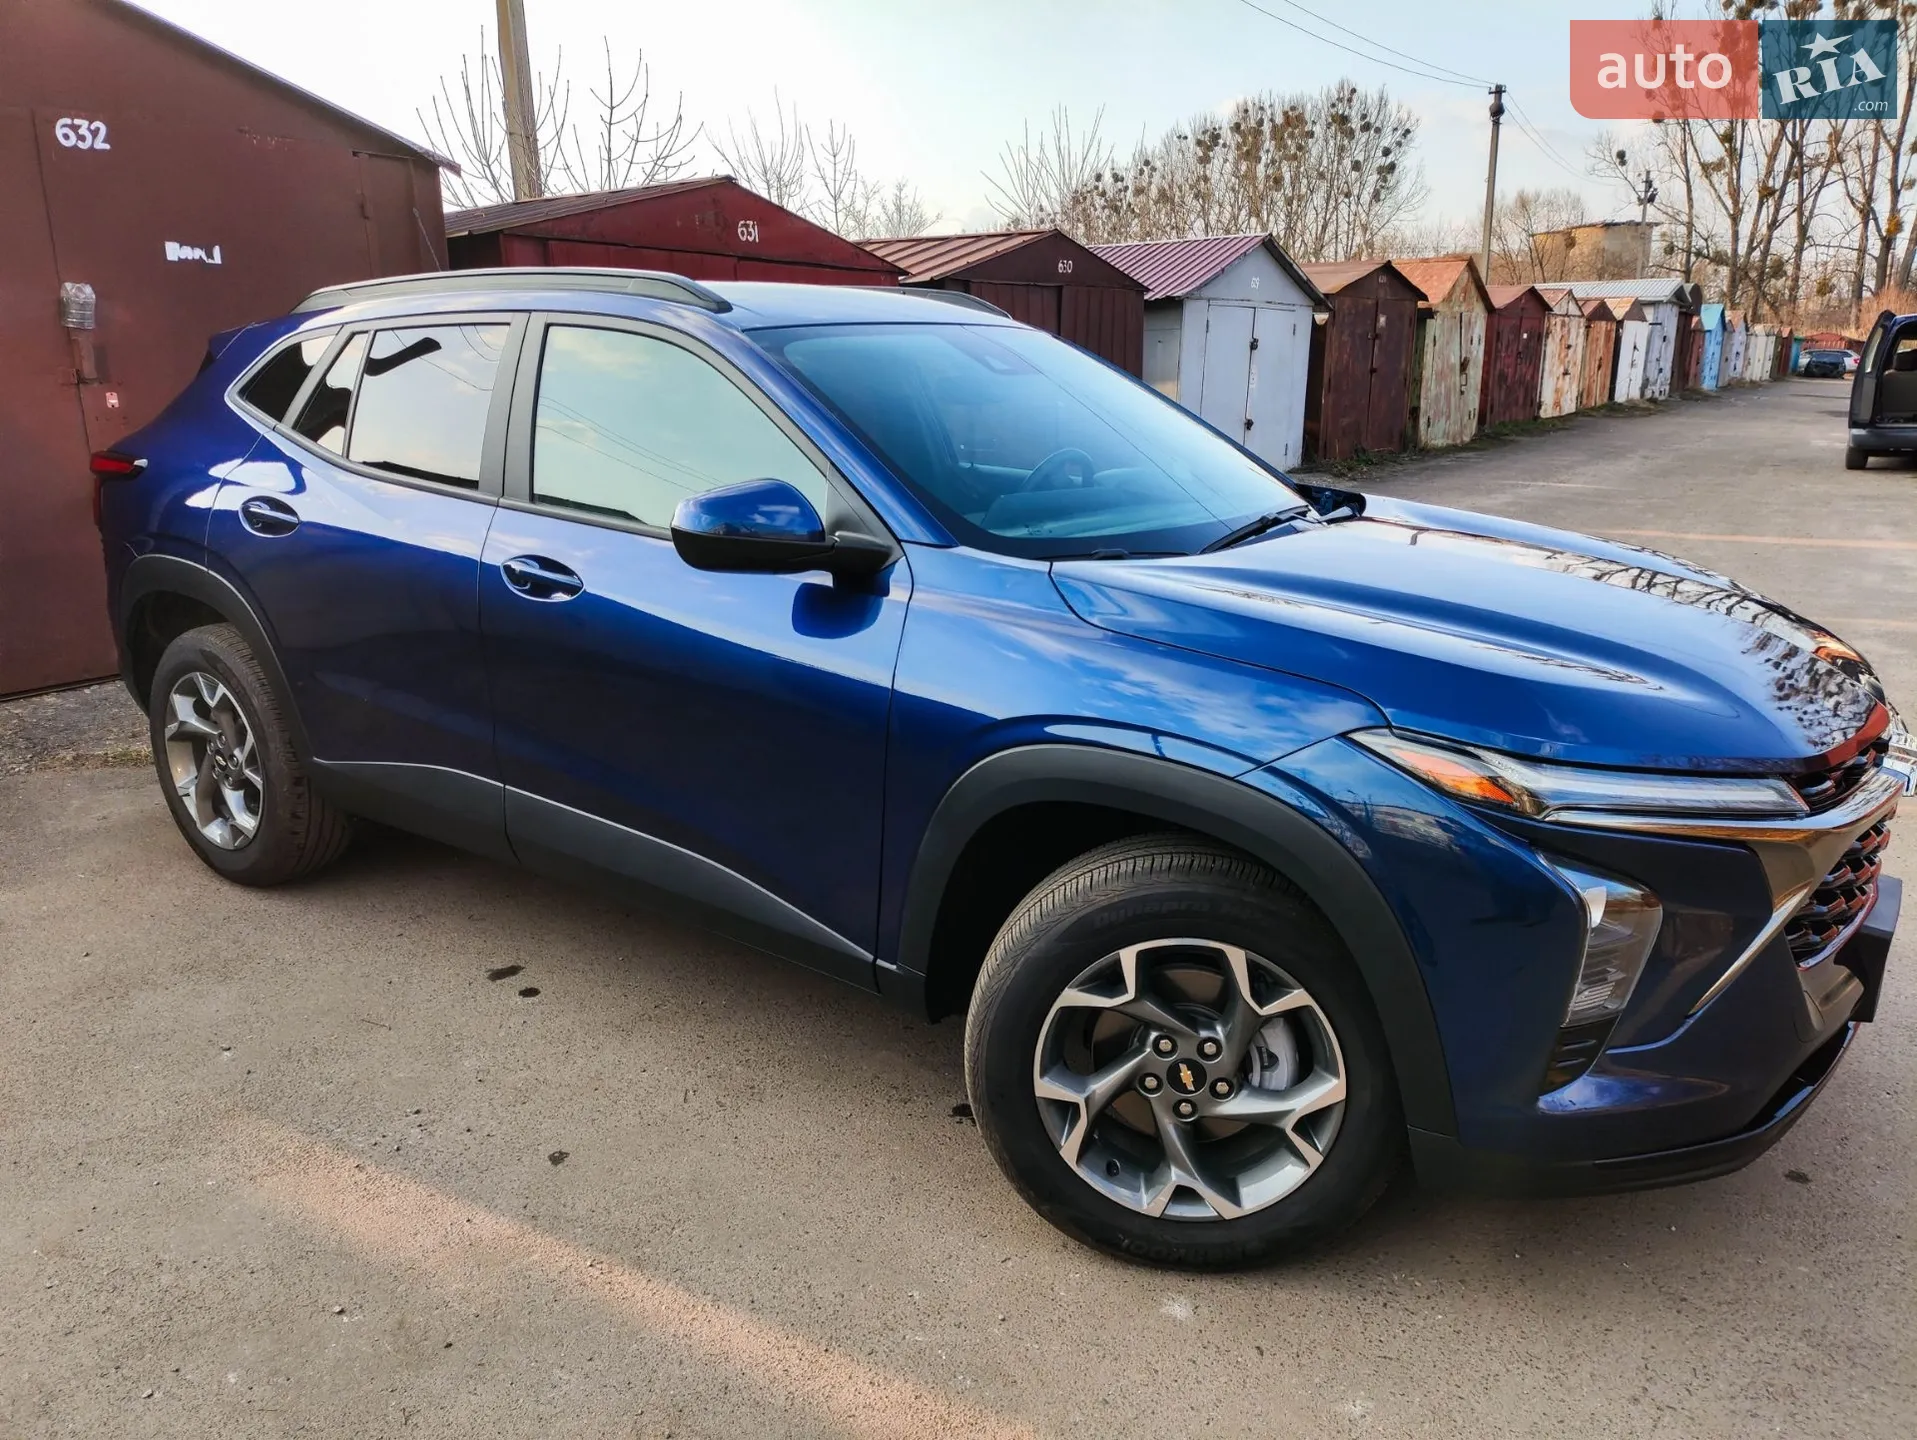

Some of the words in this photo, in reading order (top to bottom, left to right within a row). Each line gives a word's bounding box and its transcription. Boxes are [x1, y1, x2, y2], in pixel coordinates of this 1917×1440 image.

[55, 117, 111, 150] 632
[737, 219, 760, 243] 631
[1057, 259, 1073, 274] 630
